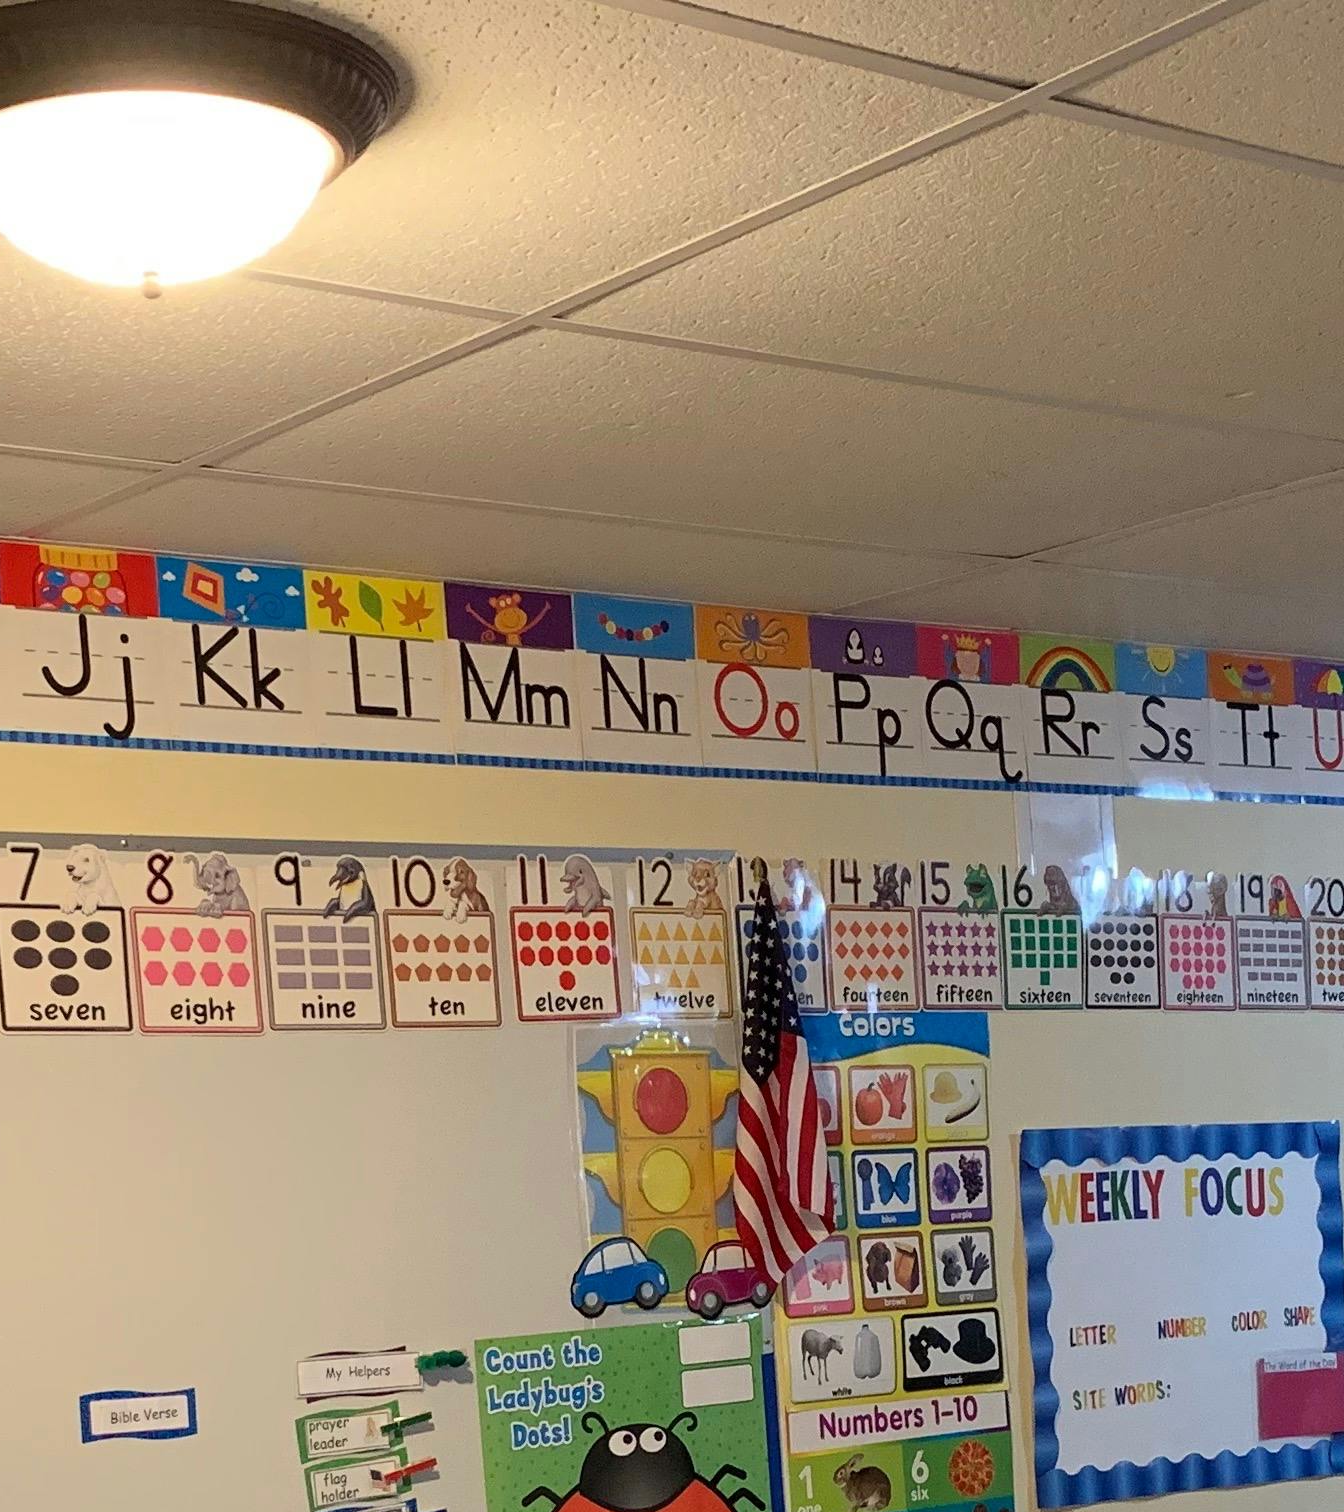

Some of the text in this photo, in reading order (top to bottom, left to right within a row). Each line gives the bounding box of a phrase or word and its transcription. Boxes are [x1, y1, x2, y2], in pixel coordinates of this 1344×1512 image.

[42, 614, 136, 739] Jj
[192, 624, 285, 709] Kk
[350, 635, 412, 717] Ll
[460, 642, 570, 726] Mm
[601, 654, 678, 733] Nn
[714, 663, 799, 740] Oo
[833, 673, 902, 776] Pp
[926, 679, 1022, 783] Qq
[1041, 688, 1100, 757] Rr
[1141, 695, 1193, 761] Ss
[1227, 702, 1279, 766] Tt
[535, 993, 603, 1014] eleven
[654, 991, 714, 1009] twelve
[842, 987, 909, 1003] fourteen
[936, 986, 993, 1004] fifteen
[1019, 988, 1071, 1004] sixteen
[1094, 990, 1151, 1004] seventeen
[1176, 990, 1223, 1006] eighteen
[1246, 988, 1298, 1005] nineteen
[30, 1000, 105, 1021] seven
[170, 1000, 235, 1026] eight
[302, 998, 357, 1020] nine
[429, 998, 465, 1016] ten
[839, 1013, 915, 1038] Colors
[1044, 1167, 1285, 1225] WEEKLY FOCUS
[1070, 1306, 1315, 1347] LETTER NUMBER COLOR SHAPE
[486, 1337, 601, 1373] Count the
[326, 1366, 390, 1379] My Helpers
[488, 1378, 604, 1413] Ladybug's
[1073, 1381, 1171, 1410] SITE WORDS:
[111, 1408, 178, 1424] Bible Verse
[818, 1396, 977, 1440] Numbers 1-10
[309, 1418, 349, 1434] prayer
[512, 1417, 570, 1448] Dots!
[310, 1437, 348, 1450] leader
[324, 1473, 347, 1486] flag
[321, 1487, 359, 1502] holder
